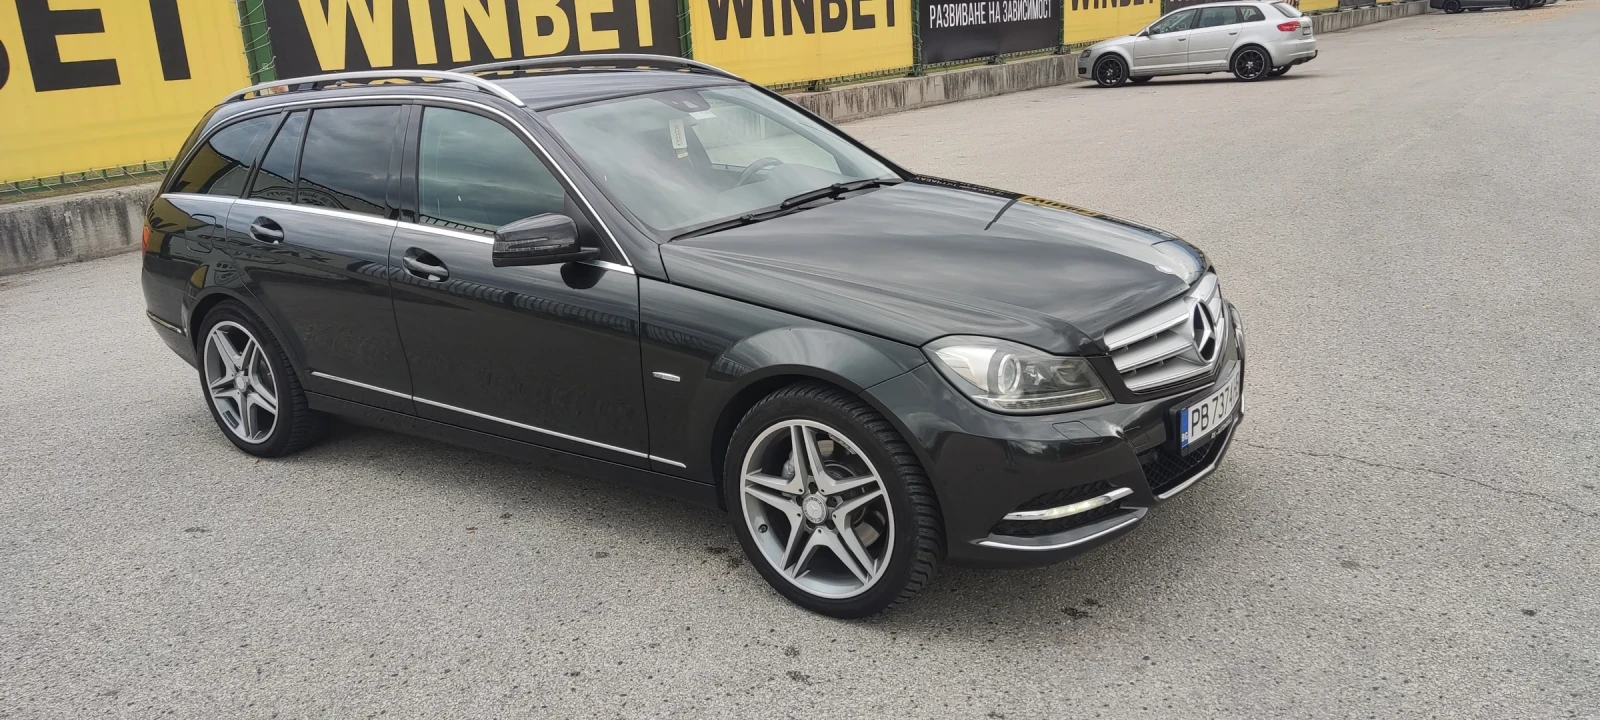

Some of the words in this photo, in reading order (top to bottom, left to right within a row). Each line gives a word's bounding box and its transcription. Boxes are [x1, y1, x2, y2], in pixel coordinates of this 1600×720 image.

[929, 2, 986, 28] РАЗВИВАНЕ
[988, 1, 1001, 23] НА
[1002, 0, 1052, 22] ЗАВИСИМОСТ
[0, 0, 192, 92] ET
[1191, 403, 1209, 436] PB
[1212, 382, 1233, 425] 7374
